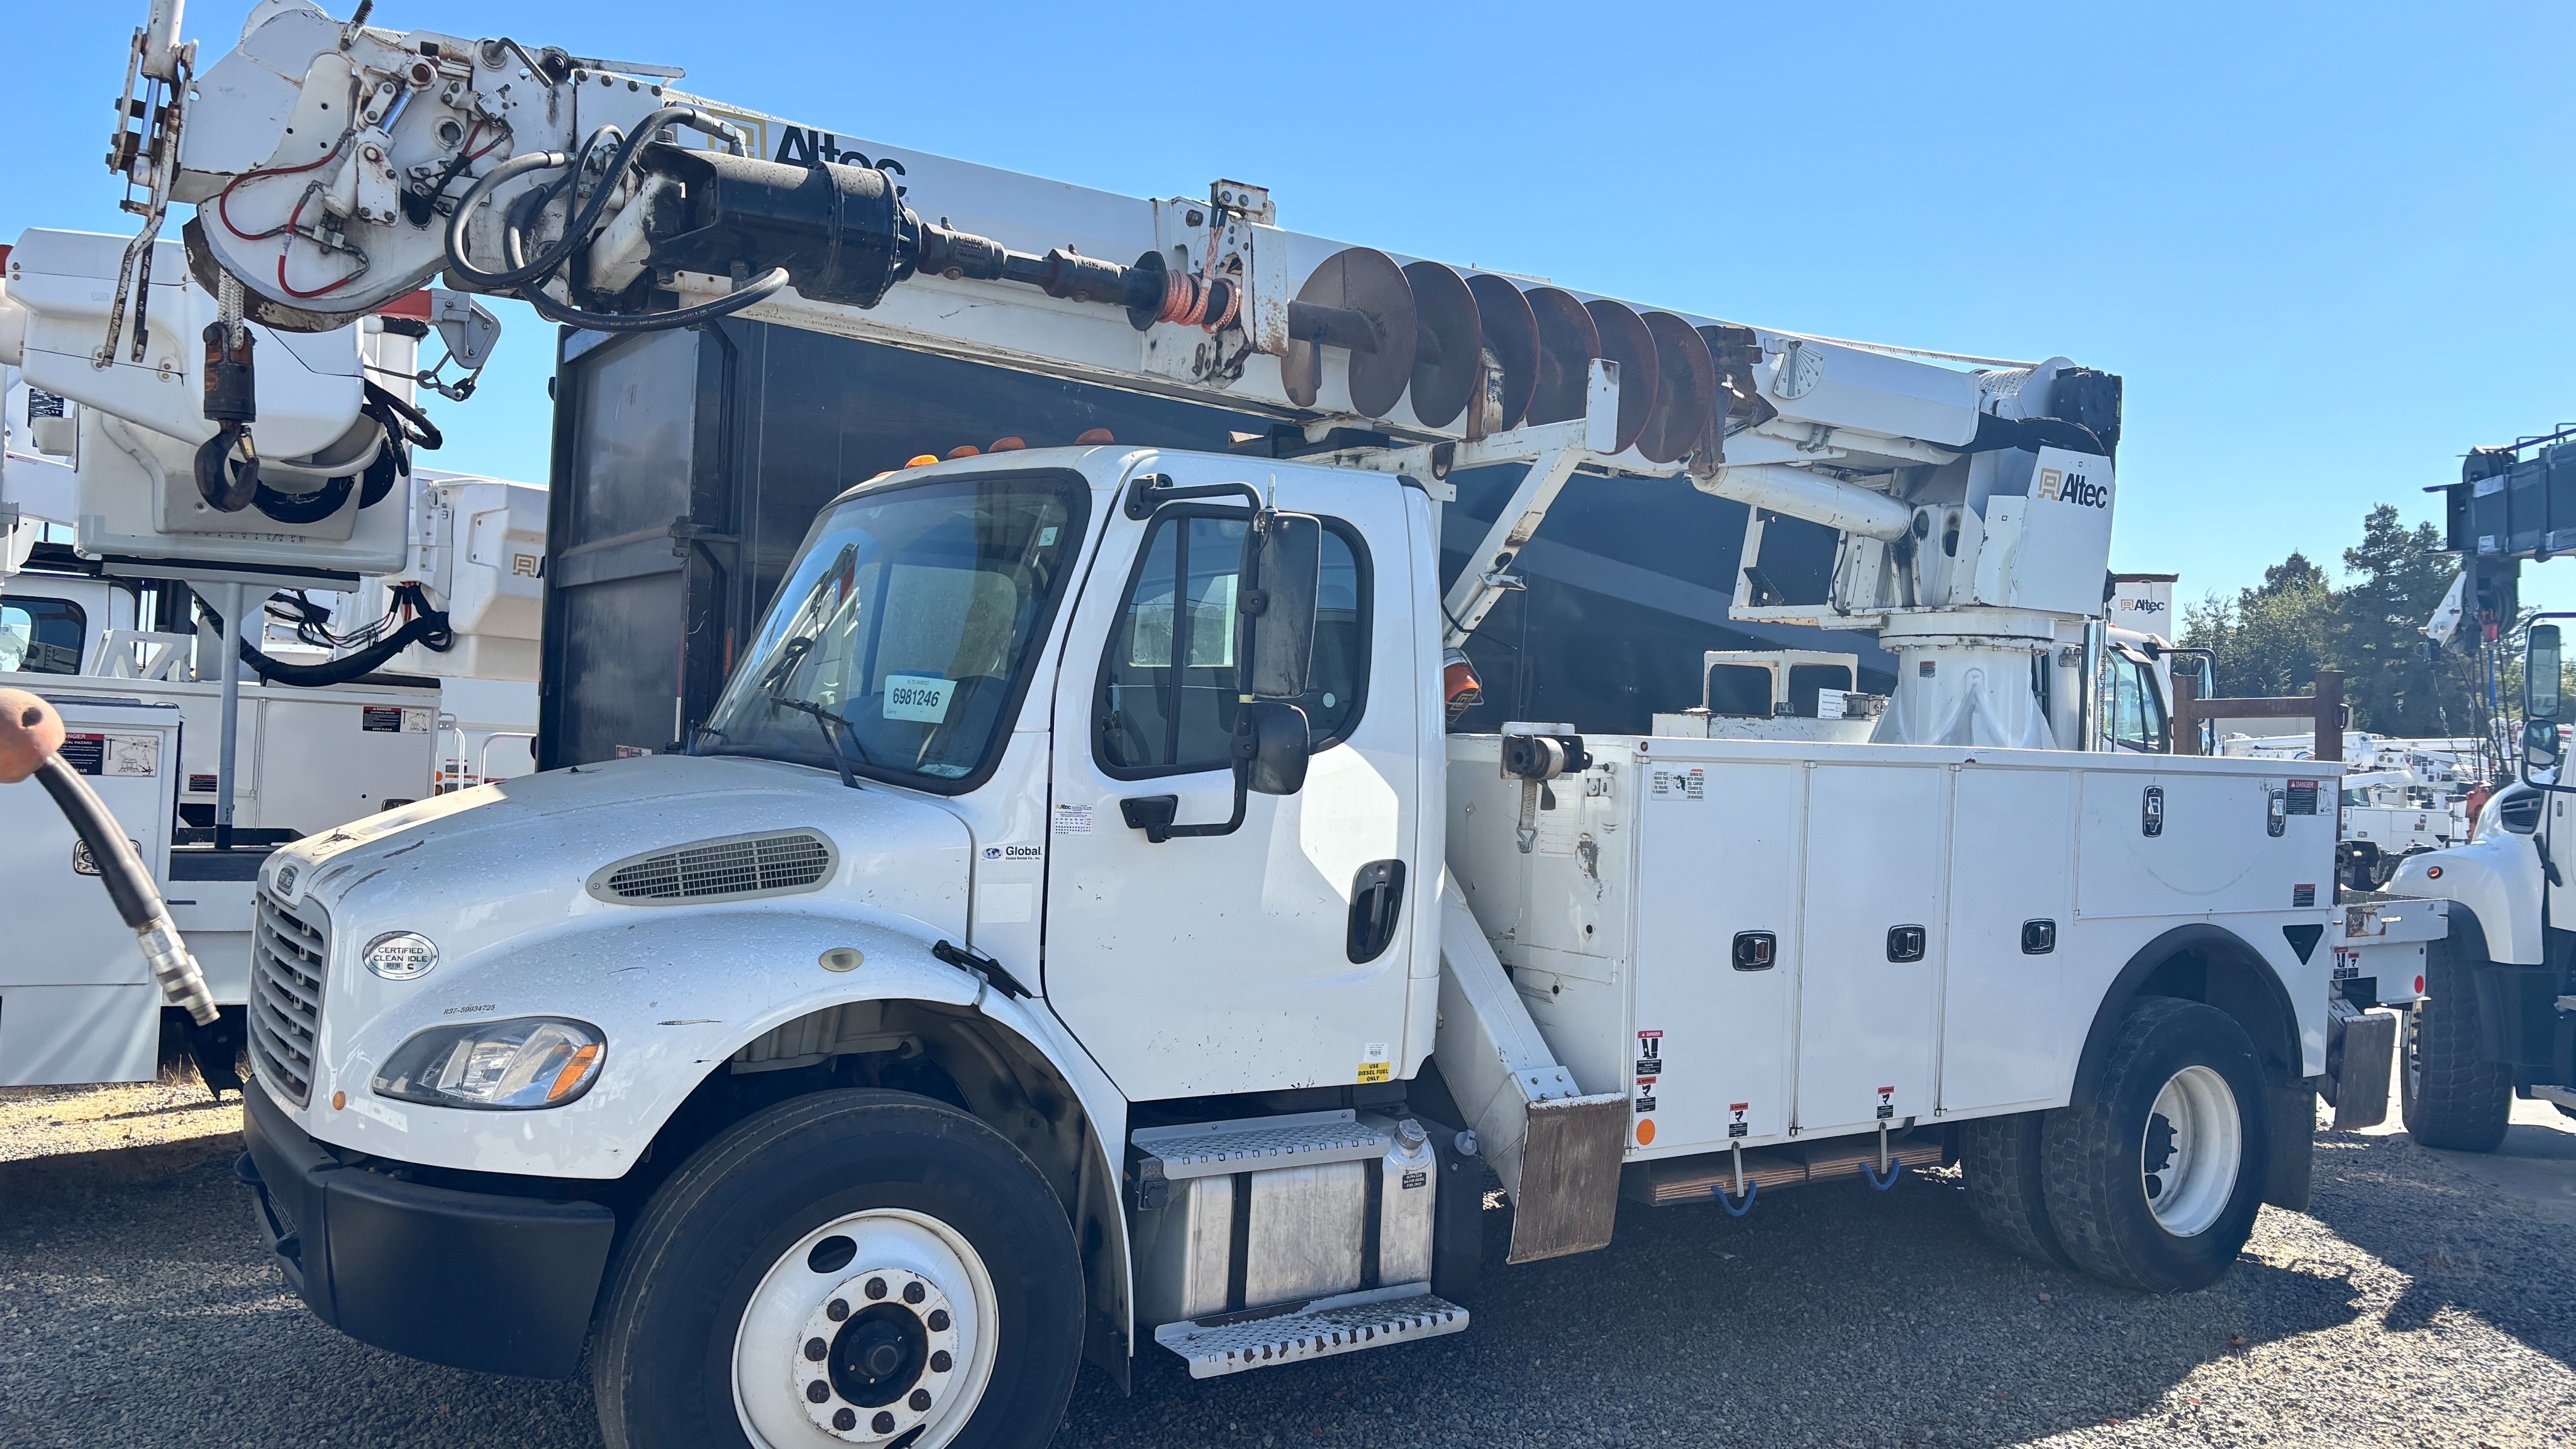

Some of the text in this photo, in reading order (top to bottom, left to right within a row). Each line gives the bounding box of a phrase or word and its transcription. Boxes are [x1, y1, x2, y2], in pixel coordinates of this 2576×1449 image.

[2058, 473, 2107, 509] Altec
[2134, 599, 2165, 611] Altec
[893, 688, 940, 707] 6981246
[1006, 846, 1041, 855] Global
